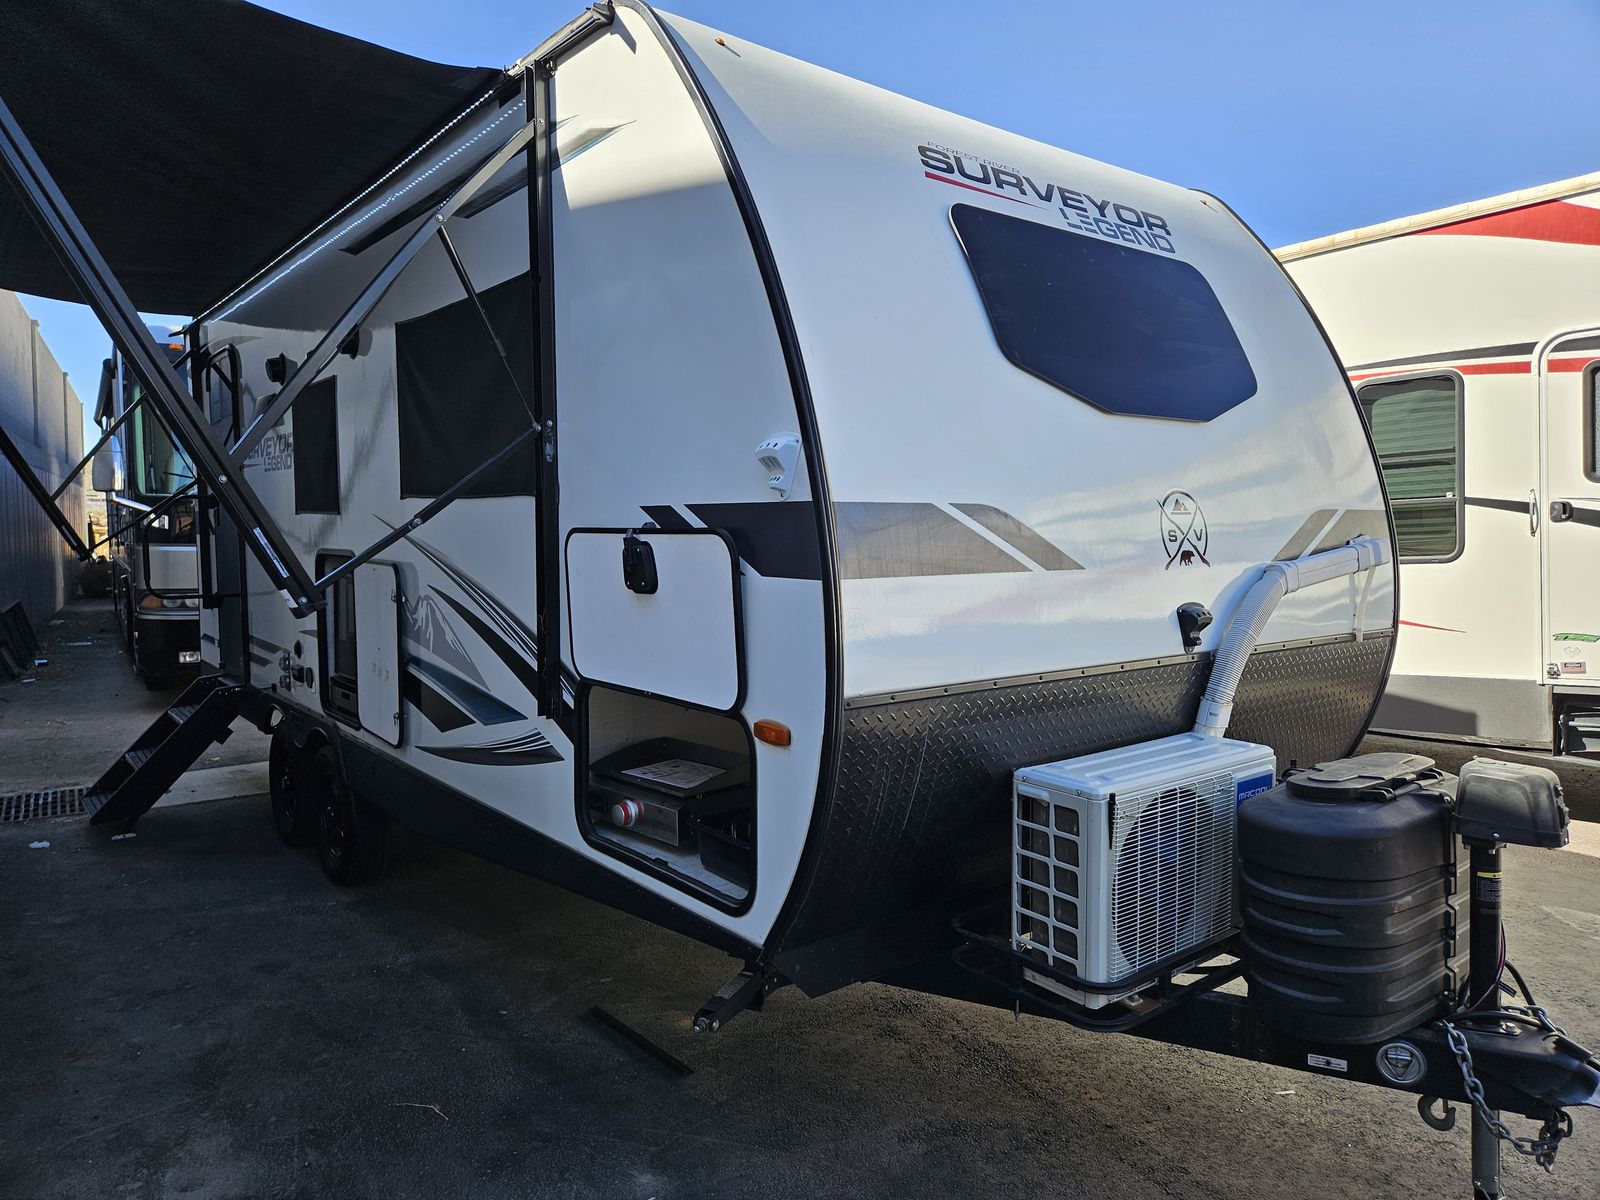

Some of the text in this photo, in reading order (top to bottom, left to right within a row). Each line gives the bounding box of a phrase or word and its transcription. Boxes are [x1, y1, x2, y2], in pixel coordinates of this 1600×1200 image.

[927, 141, 1020, 174] FOREST RIVER
[917, 145, 1172, 237] SURVEYOR
[1058, 207, 1176, 253] LEGEND
[263, 453, 292, 472] LEGEND
[1168, 529, 1203, 543] S V
